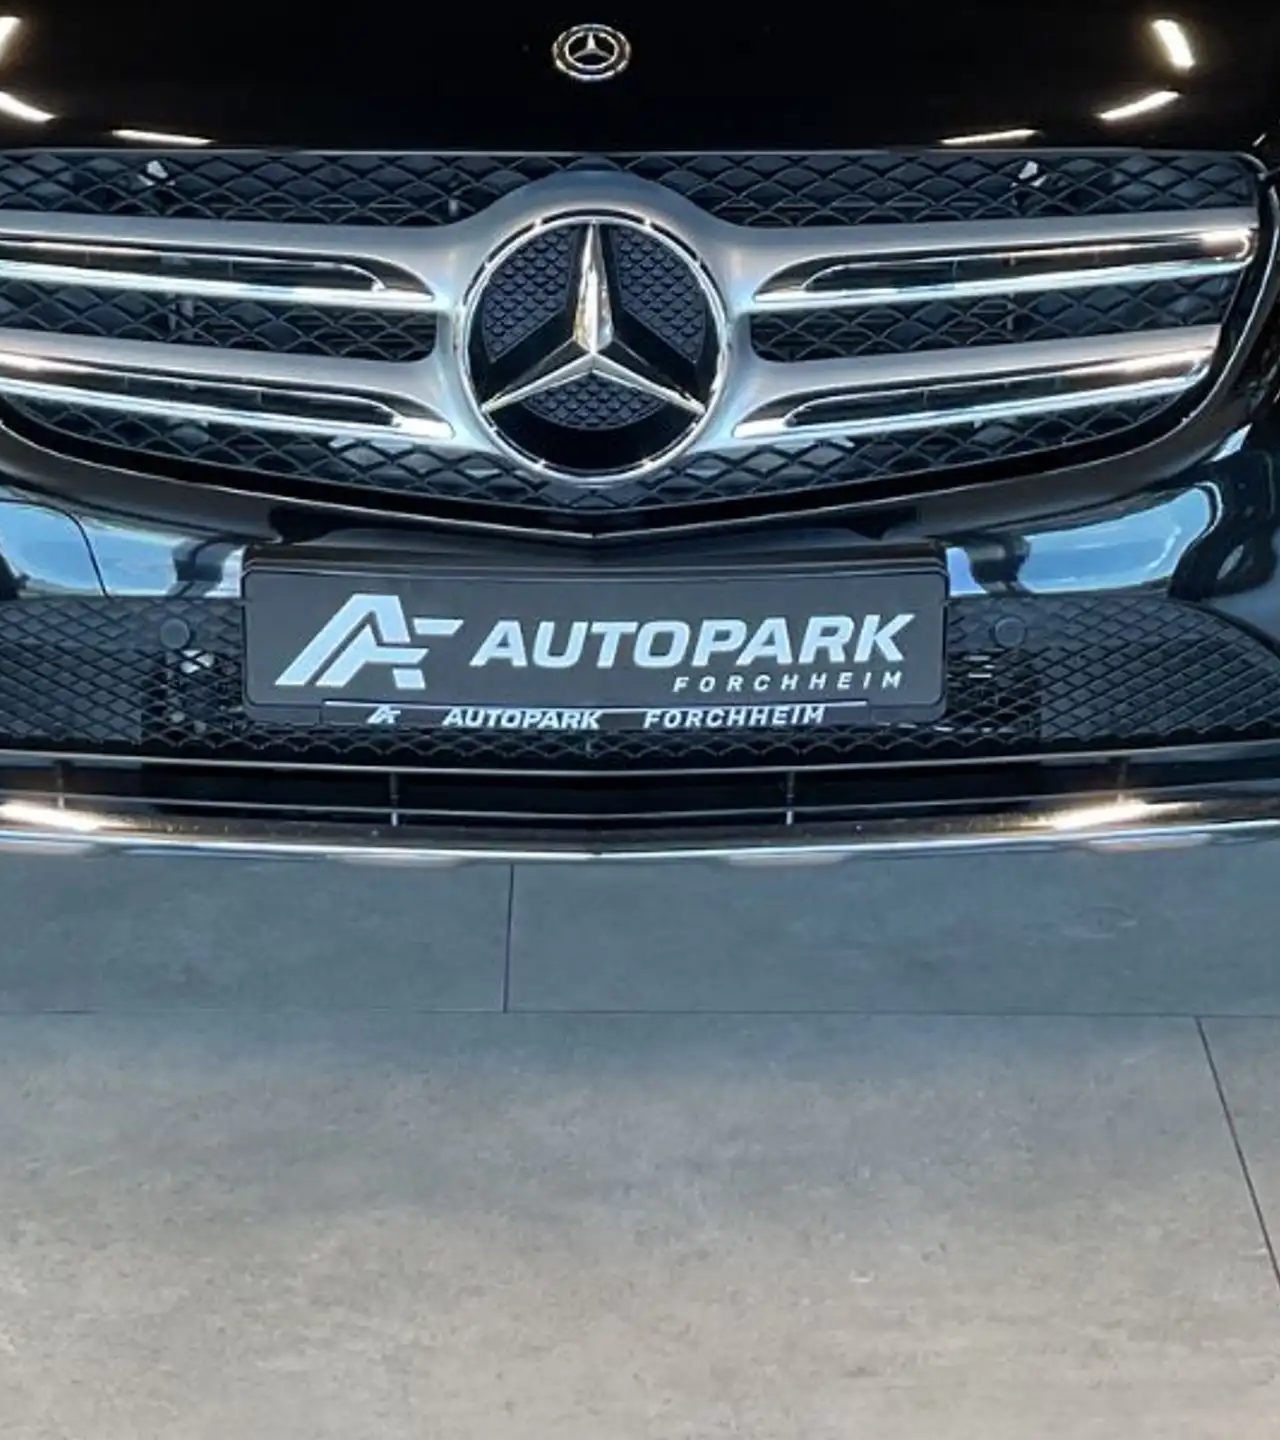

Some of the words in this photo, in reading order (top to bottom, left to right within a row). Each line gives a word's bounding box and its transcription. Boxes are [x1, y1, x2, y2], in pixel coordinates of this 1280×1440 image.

[469, 613, 915, 669] AUTOPARK
[672, 671, 905, 693] FORCHHEIM
[442, 707, 601, 730] AUTOPARK
[643, 705, 826, 729] FORCHHEIM
